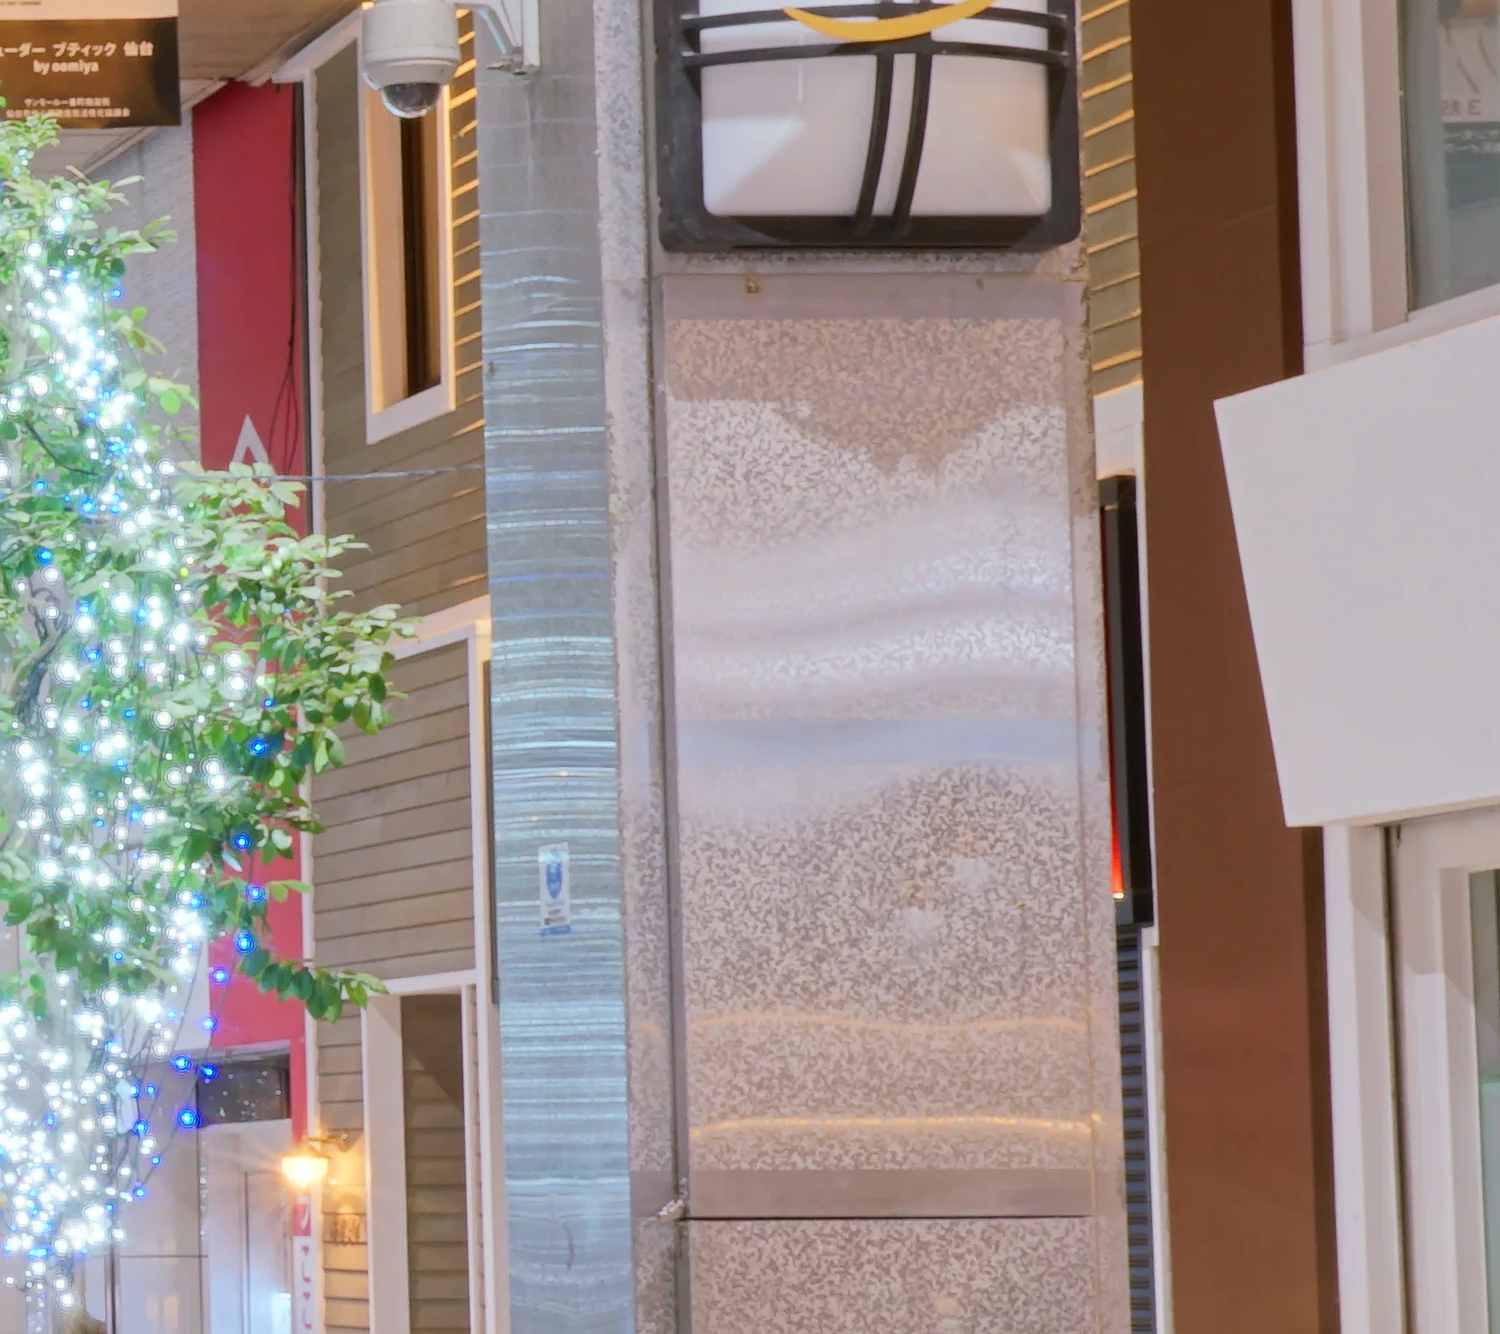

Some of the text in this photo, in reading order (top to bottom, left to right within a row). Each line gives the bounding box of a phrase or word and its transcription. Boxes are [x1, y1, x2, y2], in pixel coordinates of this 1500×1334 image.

[52, 41, 117, 58] ブティック
[33, 59, 50, 75] by
